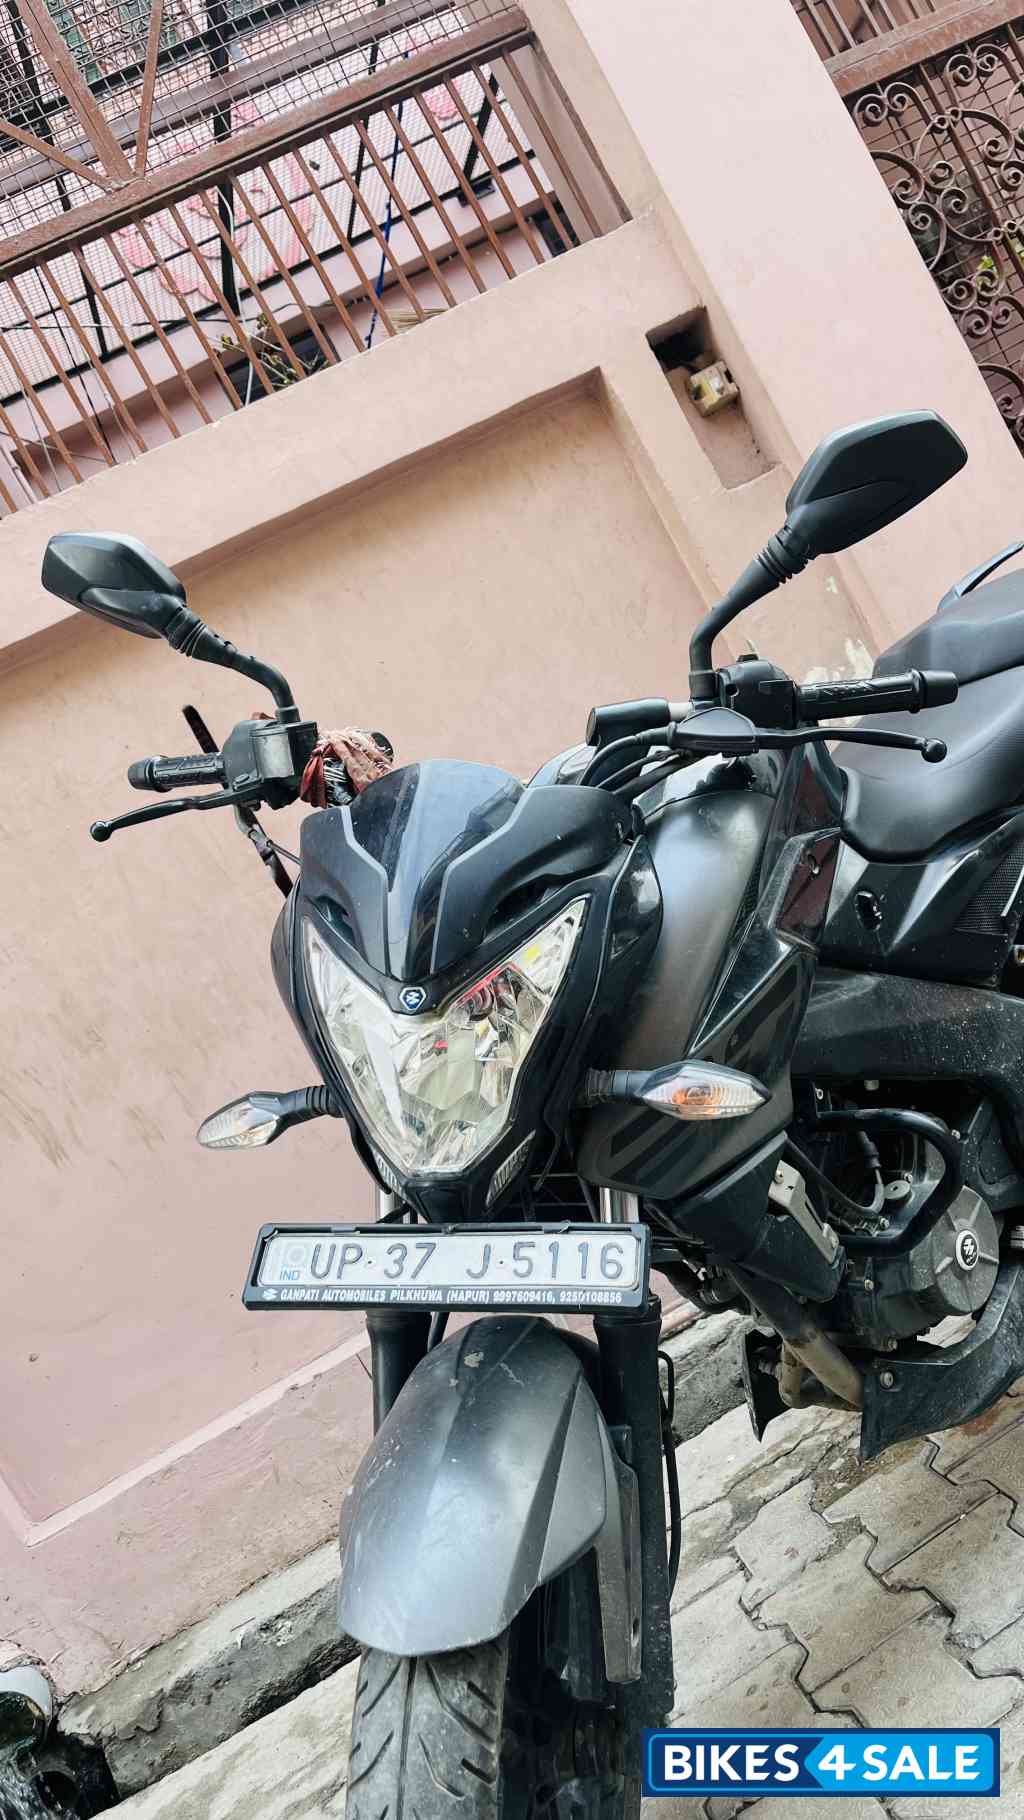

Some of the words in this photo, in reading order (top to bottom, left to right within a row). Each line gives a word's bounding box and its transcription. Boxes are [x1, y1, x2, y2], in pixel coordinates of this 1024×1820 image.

[310, 1242, 363, 1280] UP
[383, 1242, 437, 1280] 37
[465, 1243, 492, 1280] J
[512, 1240, 624, 1280] 5116
[279, 1269, 300, 1281] IND
[280, 1288, 320, 1301] GANPATI
[321, 1288, 386, 1302] AUTOMOBILES
[389, 1289, 443, 1302] PILKHUWA
[446, 1289, 490, 1304] (HAPUR)
